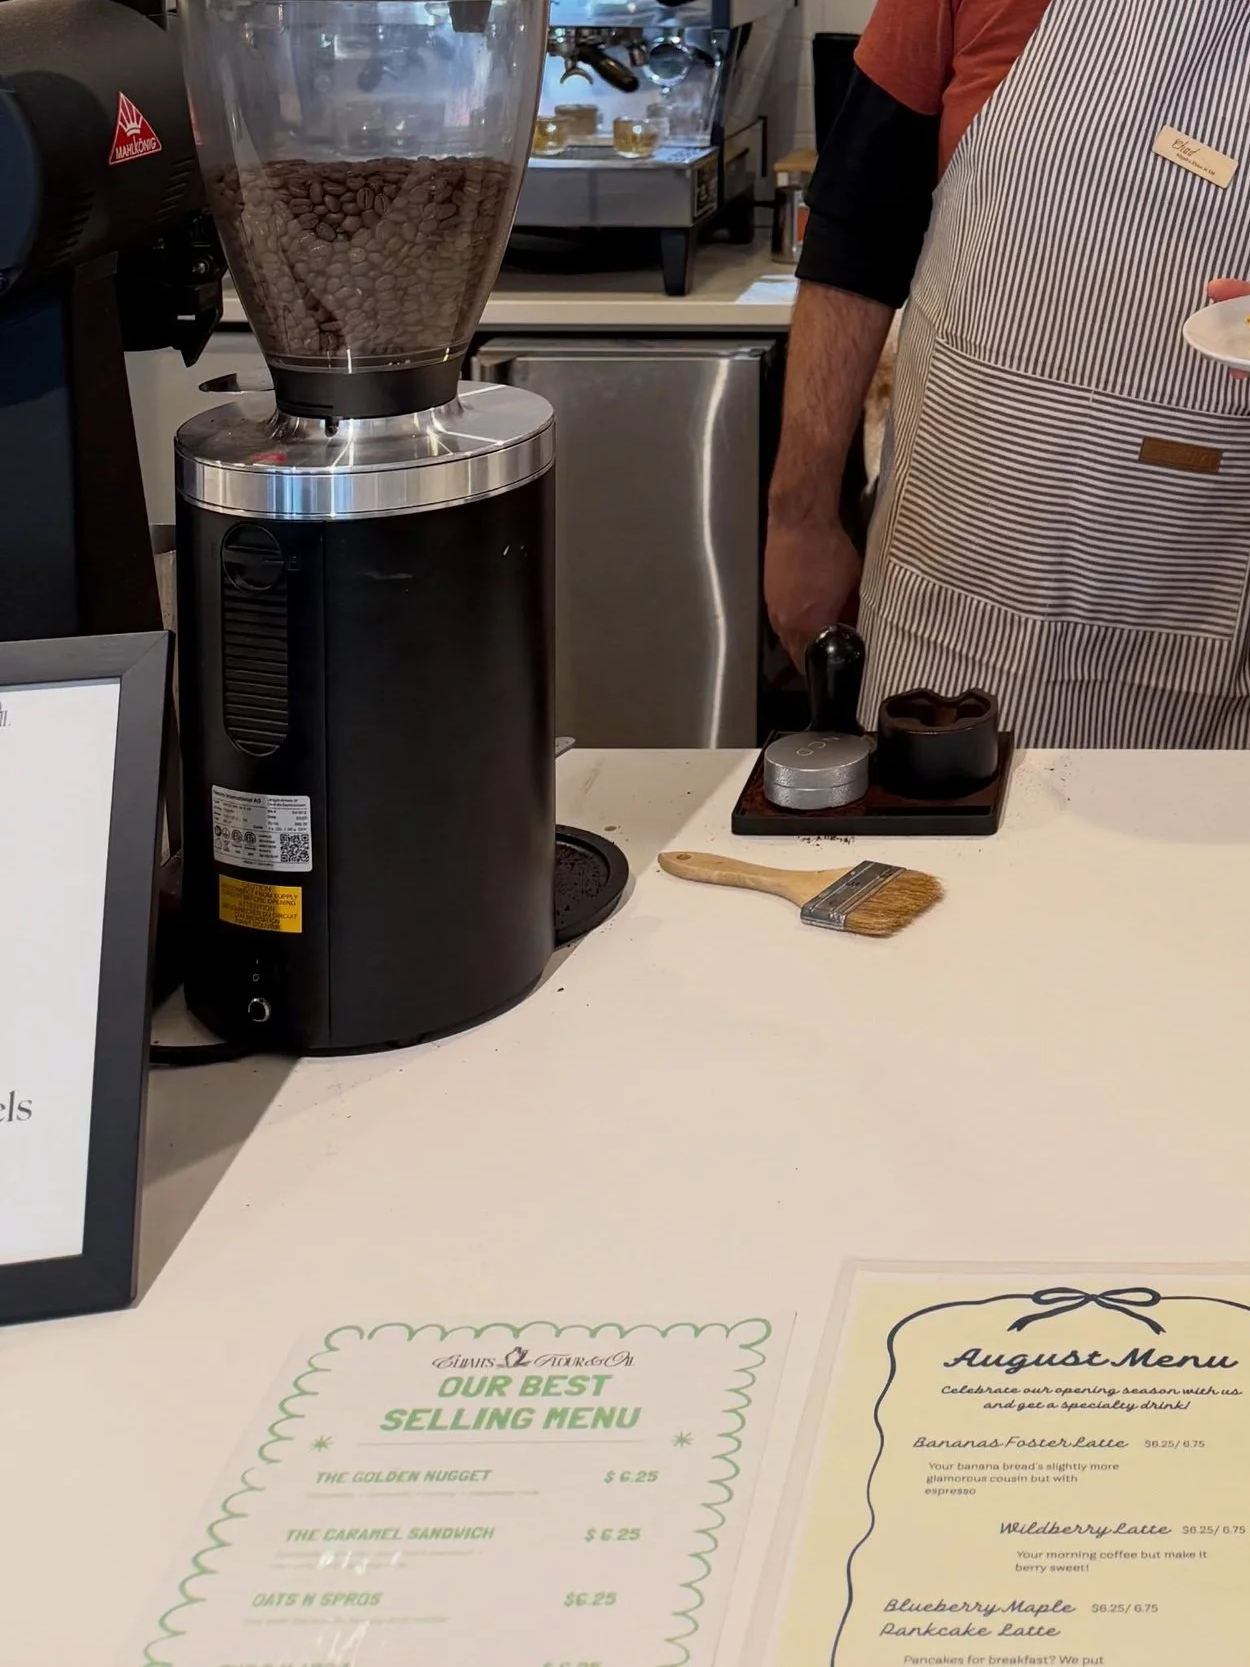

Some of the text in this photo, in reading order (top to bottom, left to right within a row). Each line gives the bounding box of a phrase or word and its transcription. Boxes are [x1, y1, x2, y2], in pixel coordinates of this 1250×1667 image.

[943, 1347, 1240, 1375] August Menu
[438, 1374, 613, 1397] OUR BEST
[941, 1384, 1243, 1397] Celebrate our opening season with us
[983, 1399, 1192, 1413] and get a specialty drink!
[380, 1406, 642, 1431] SELLING MENU
[912, 1436, 1004, 1448] Bananas
[1004, 1436, 1073, 1449] Foster
[1072, 1436, 1129, 1448] Latte
[929, 1461, 1120, 1473] Your banana bread's slightly more
[316, 1471, 349, 1484] THE
[352, 1470, 420, 1484] GOLDEN
[424, 1469, 493, 1483] NUGGET
[926, 1474, 1078, 1485] glamorous cousin but with
[924, 1487, 976, 1497] espresso
[286, 1529, 320, 1542] THE
[323, 1528, 401, 1542] CARAMEL
[408, 1526, 495, 1540] SANDWICH
[1000, 1521, 1112, 1539] Wildberry
[1112, 1521, 1172, 1535] Latte
[1016, 1550, 1207, 1562] Your morning coffee but make it
[1015, 1563, 1089, 1575] berry sweet!
[252, 1592, 299, 1607] OATS
[301, 1592, 316, 1606] N
[564, 1591, 618, 1608] $6.25
[883, 1598, 1001, 1618] Blueberry
[1001, 1599, 1077, 1618] Maple
[879, 1622, 1062, 1637] Pankcake Latte
[904, 1654, 1105, 1667] Pancakes for breakfast? We put
